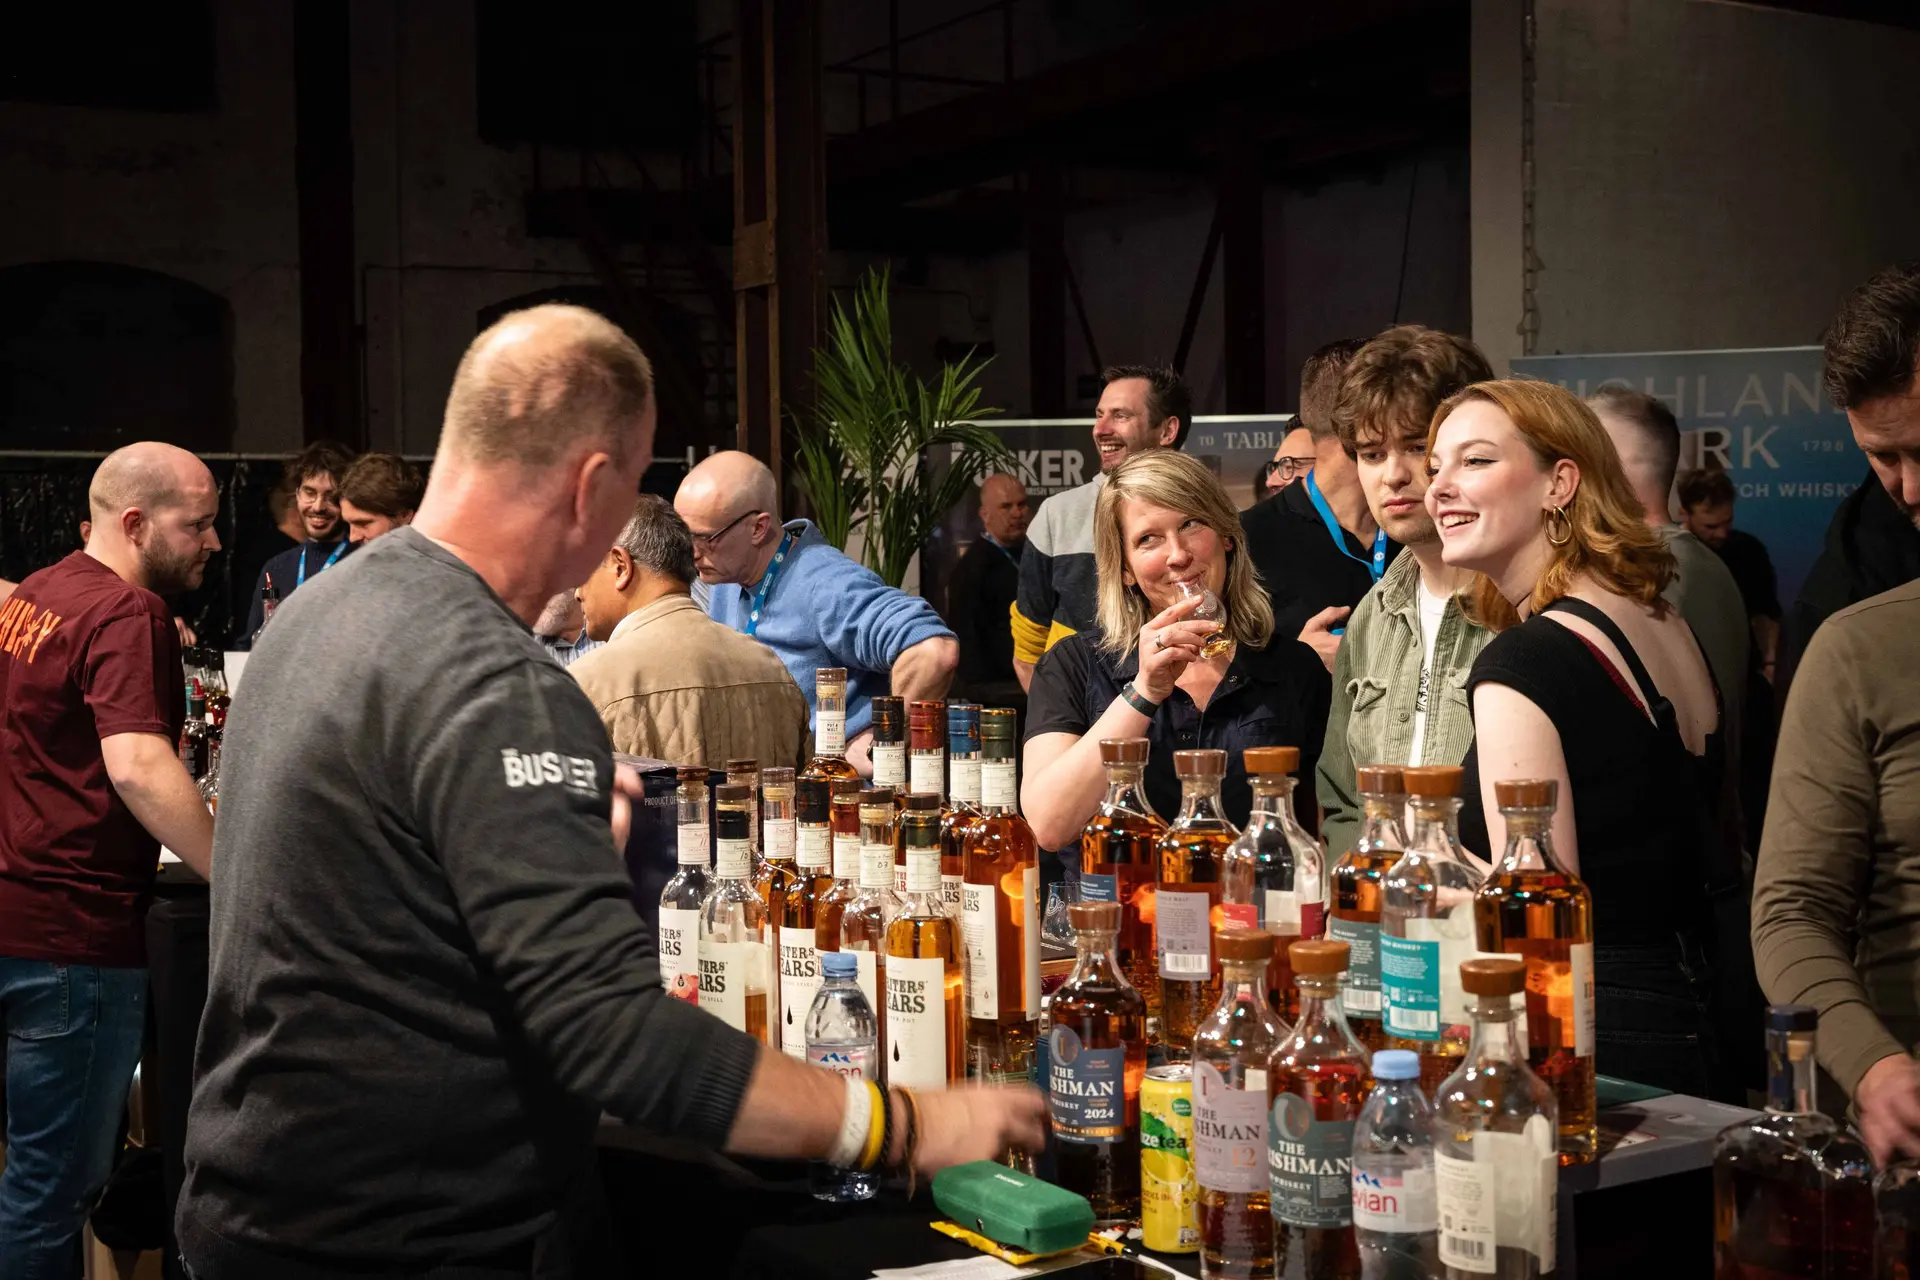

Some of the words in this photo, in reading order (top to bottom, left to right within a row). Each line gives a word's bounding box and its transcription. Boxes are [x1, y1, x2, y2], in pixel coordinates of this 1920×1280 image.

[1223, 432, 1285, 449] TABL
[698, 973, 726, 993] ARS
[1053, 1065, 1075, 1080] THE
[1084, 1108, 1115, 1119] 2024
[1197, 1105, 1217, 1121] THE
[1278, 1139, 1306, 1156] THE
[1233, 1146, 1257, 1168] 12
